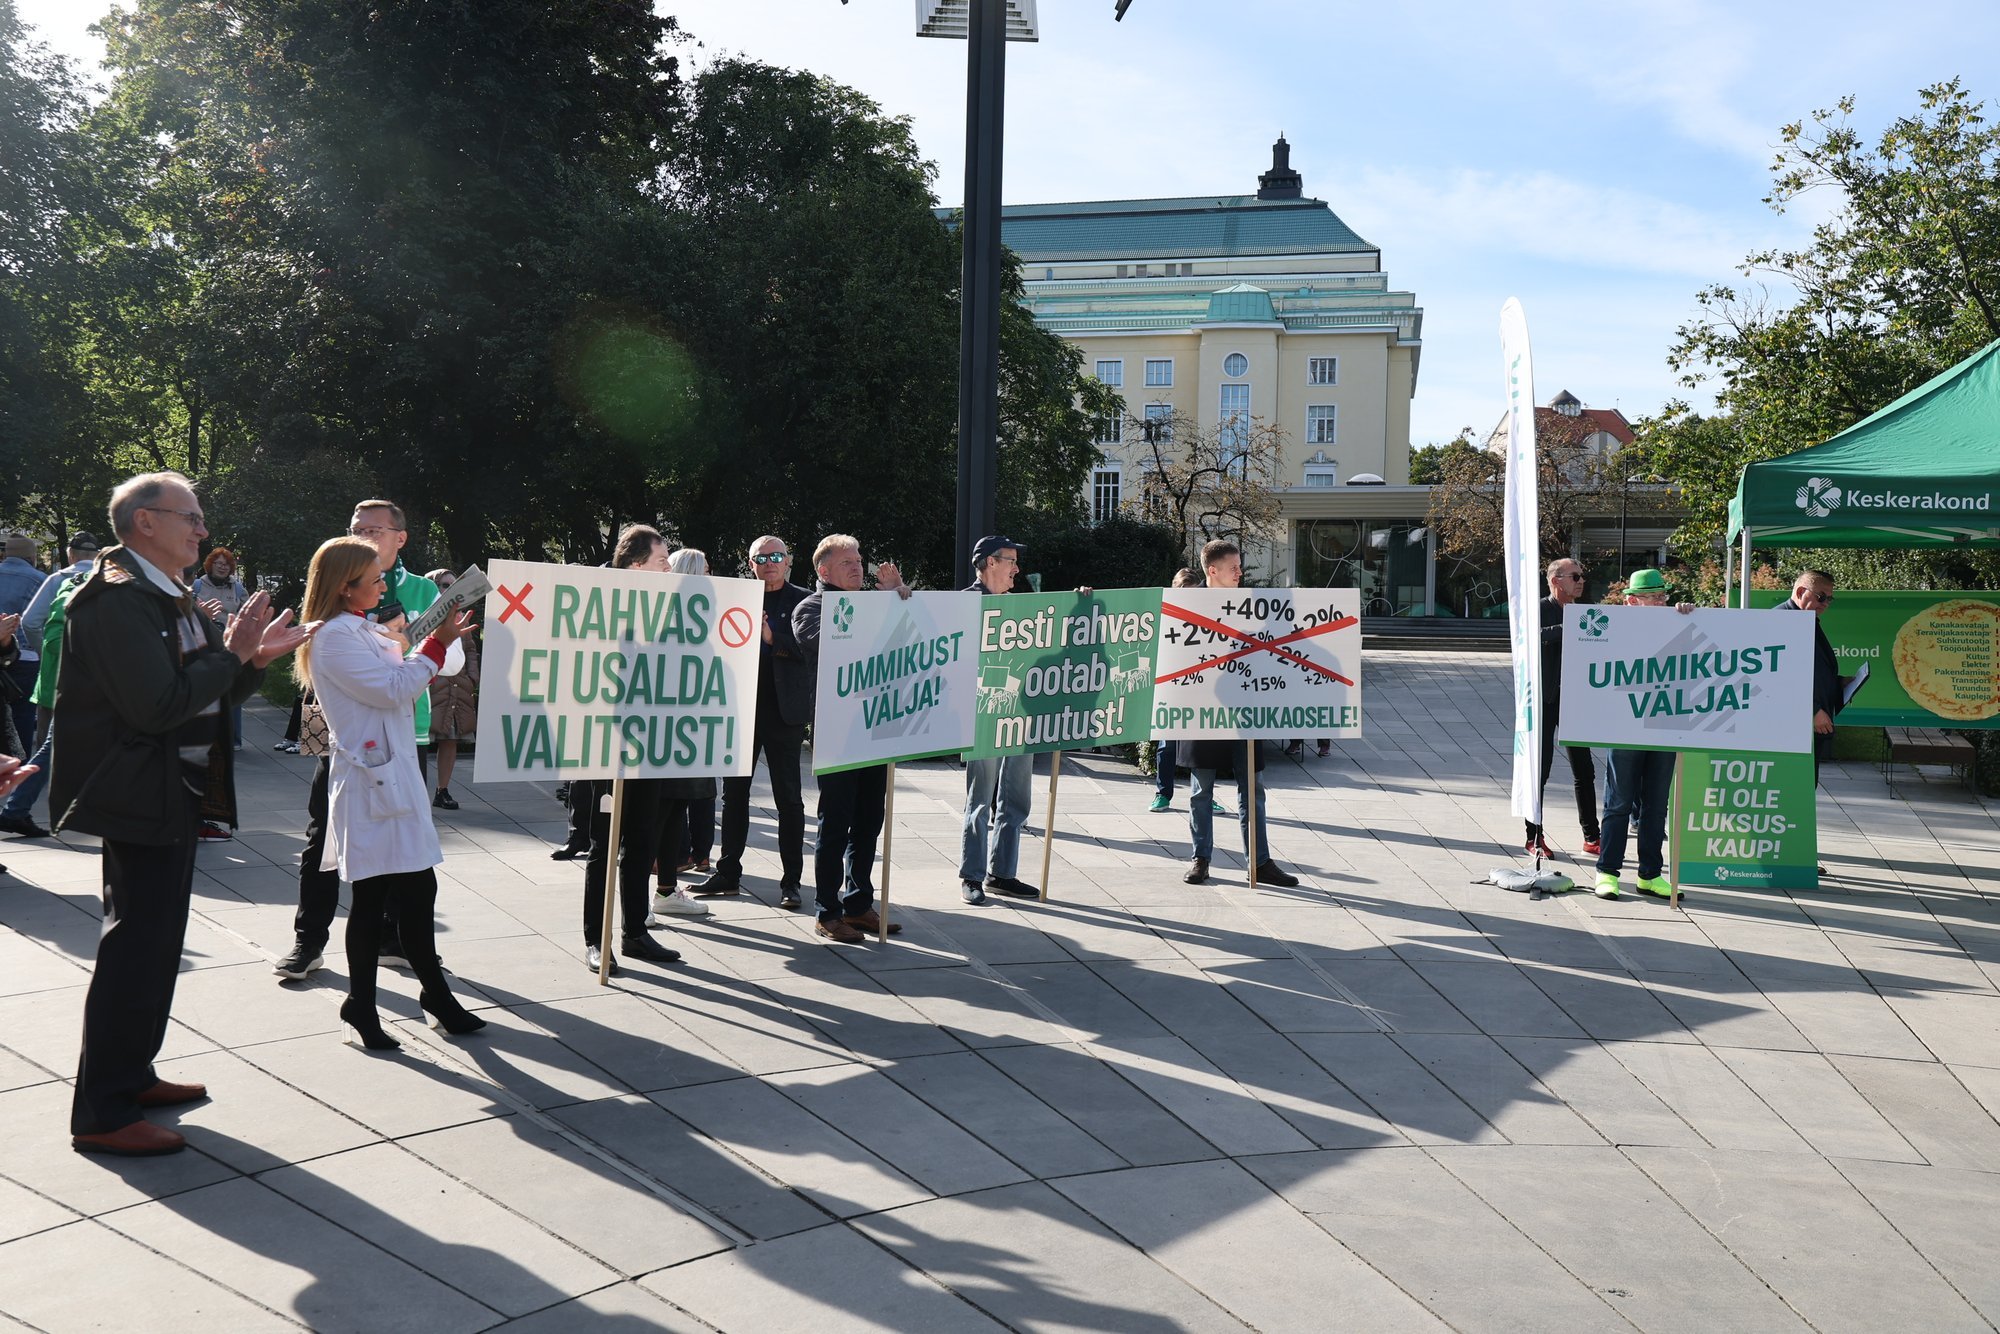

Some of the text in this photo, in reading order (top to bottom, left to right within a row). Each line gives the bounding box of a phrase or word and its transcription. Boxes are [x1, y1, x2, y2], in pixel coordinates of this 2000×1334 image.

[1847, 490, 1990, 510] Keskerakond
[551, 584, 709, 645] RAHVAS
[1221, 597, 1295, 622] +40%
[980, 604, 1155, 653] Eesti rahvas
[1929, 621, 1989, 629] Kanakasvataja
[1936, 637, 1990, 645] Suhkrutootja
[519, 648, 728, 706] EI USALDA
[836, 631, 964, 698] UMMIKUST
[1024, 652, 1107, 698] ootab
[1588, 645, 1786, 689] UMMIKUST
[1240, 675, 1286, 692] +15%
[1951, 677, 1991, 685] Transport
[862, 675, 942, 730] VÄLJA!
[1628, 682, 1750, 718] VÄLJA!
[994, 696, 1126, 749] muutust!
[1150, 702, 1358, 730] ÕPP MAKSUKAOSELE!
[501, 714, 735, 769] VALITSUST!
[1710, 759, 1774, 783] TOIT
[1703, 788, 1781, 809] EI OLE
[1687, 812, 1796, 833] LUKSUS-
[1705, 838, 1781, 860] KAUP!
[1729, 870, 1773, 880] Keskerakond
